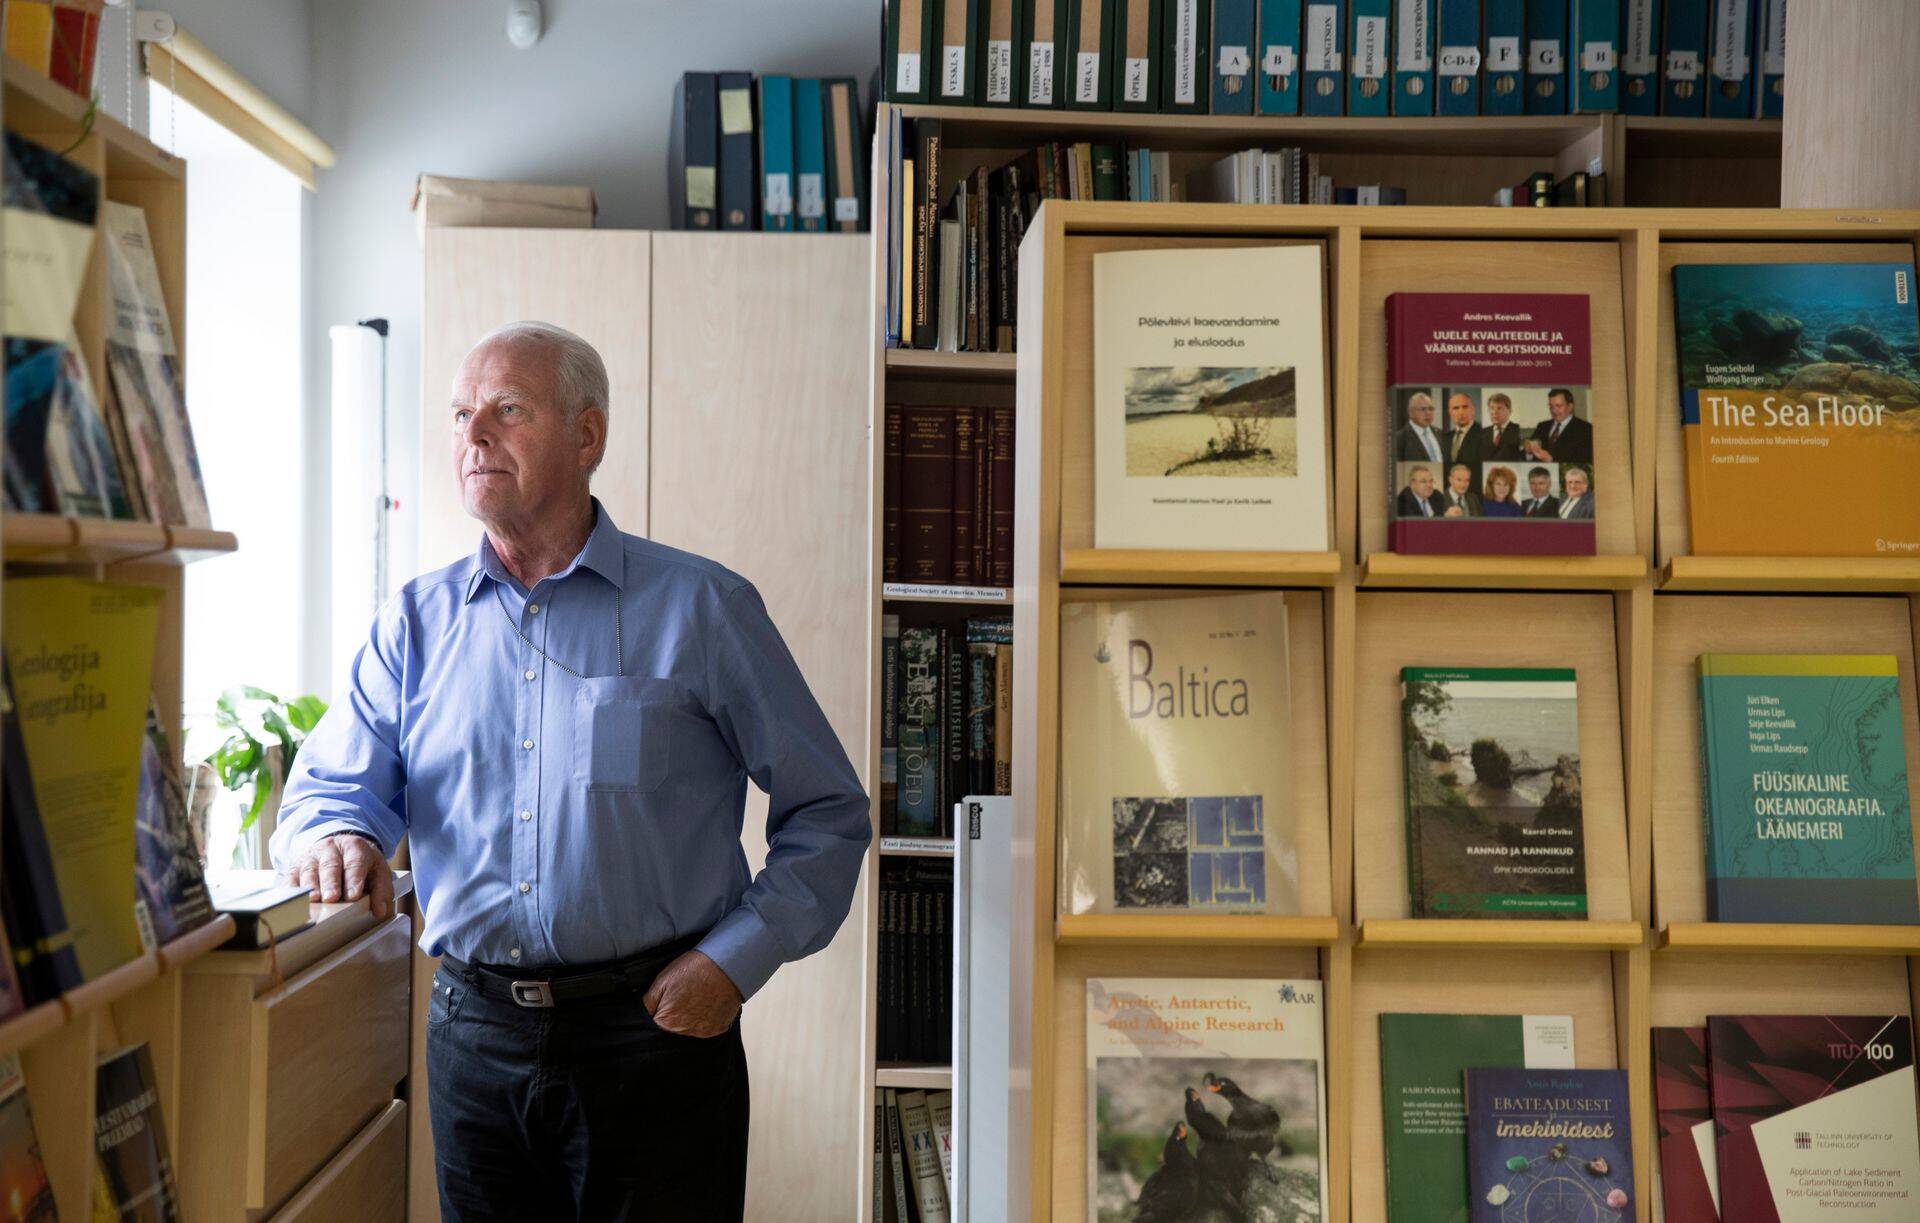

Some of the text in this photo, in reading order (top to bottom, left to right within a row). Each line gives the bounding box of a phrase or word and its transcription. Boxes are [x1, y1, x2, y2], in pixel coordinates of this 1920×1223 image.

[1366, 21, 1375, 74] BERGLUND
[1274, 55, 1282, 64] B
[1500, 48, 1511, 61] F
[1540, 50, 1554, 64] G
[1232, 56, 1240, 65] A
[1443, 56, 1478, 66] C-D-E
[1138, 316, 1280, 327] Põlevkivi kaevandamine
[1464, 313, 1532, 321] Andres Keevallik
[1433, 331, 1564, 342] UUELE KVALITEEDILE JA
[1174, 337, 1245, 348] ja elusloodus
[1425, 343, 1573, 355] VÄÄRIKALE POSITSIOONILE
[1706, 364, 1755, 374] Eugen Seibold
[1706, 375, 1764, 385] Wolfgang Berger
[1707, 397, 1885, 427] The Sea Floor
[1711, 437, 1720, 445] An
[1722, 437, 1766, 445] Introduction
[1775, 437, 1799, 445] Marine
[1801, 437, 1829, 447] Geology
[1711, 455, 1760, 464] Fourth Edition
[886, 585, 918, 596] Geological
[919, 587, 940, 597] Society
[1129, 639, 1249, 719] Baltica
[1761, 697, 1780, 705] Elken
[952, 653, 961, 761] EESTI KAITSEALAD
[1748, 708, 1785, 719] Urmas Lips
[1766, 720, 1796, 729] Keevallik
[905, 662, 930, 806] EESTI JÕED
[1750, 732, 1780, 742] Inga Lips
[1751, 744, 1808, 755] Urmas Raudsepp
[1753, 771, 1850, 792] FÜÜSIKALINE
[1755, 798, 1886, 816] OKEANOGRAAFIA.
[1522, 828, 1573, 836] Kaarel Orviku
[1757, 819, 1843, 840] LÄÄNEMERI
[1467, 846, 1574, 856] RANNAD JA RANNIKUD
[1513, 866, 1574, 874] KÕRGKOOLIDELE
[1109, 995, 1252, 1011] Arctic, Antarctic,
[1109, 1016, 1285, 1034] and Alpine Research
[1494, 1098, 1612, 1112] EBATEADUSEST
[1496, 1120, 1614, 1139] imekividest
[1790, 1167, 1832, 1178] Application
[1844, 1168, 1862, 1176] Lake
[1864, 1168, 1901, 1177] Sediment
[1799, 1178, 1862, 1188] Carbon/Nitrogen
[1863, 1179, 1884, 1187] Ratio
[1786, 1189, 1909, 1199] Post-Glacial Paleoenvironmental
[1819, 1200, 1876, 1208] Reconstruction
